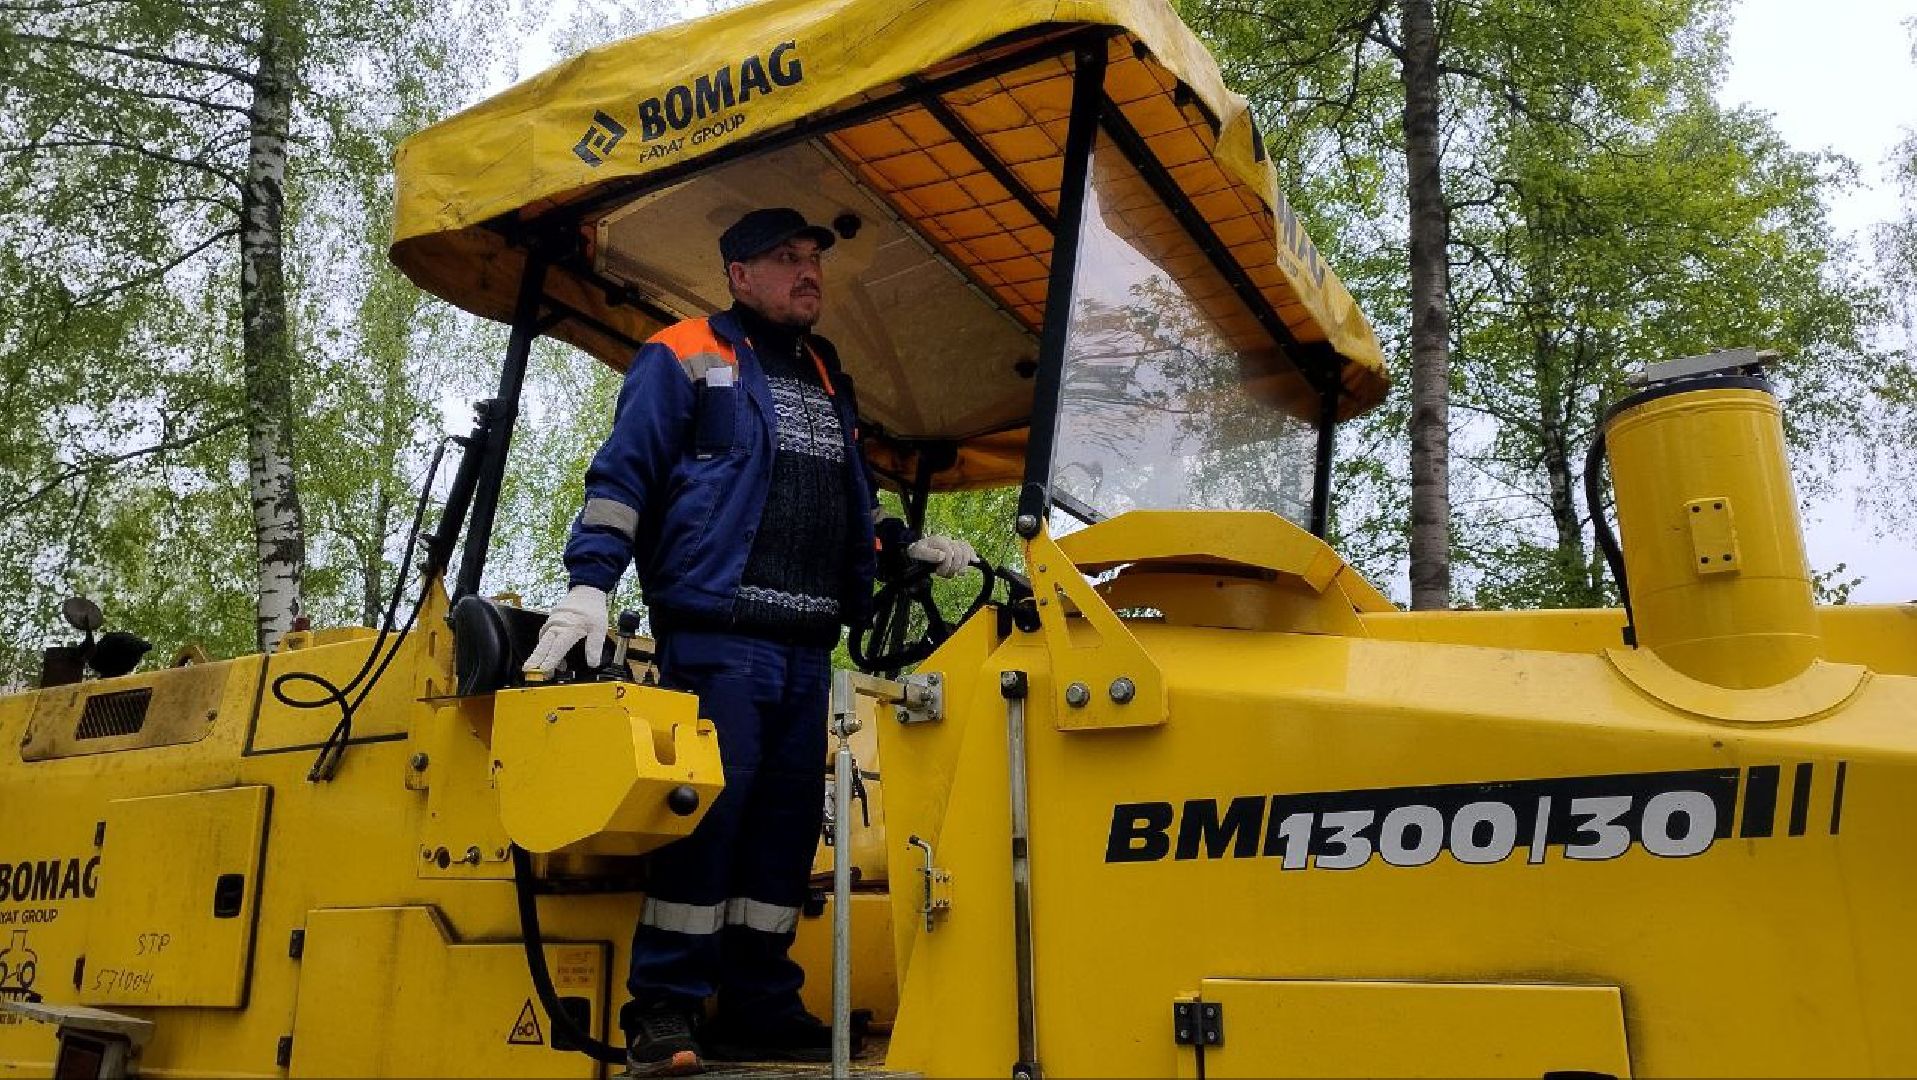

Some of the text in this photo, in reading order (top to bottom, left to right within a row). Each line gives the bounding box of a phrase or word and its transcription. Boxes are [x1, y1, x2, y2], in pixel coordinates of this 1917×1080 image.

[638, 40, 803, 142] BOMAG
[640, 113, 745, 163] FAYAT GROUP
[1105, 795, 1267, 863] BM
[22, 908, 58, 924] GROUP
